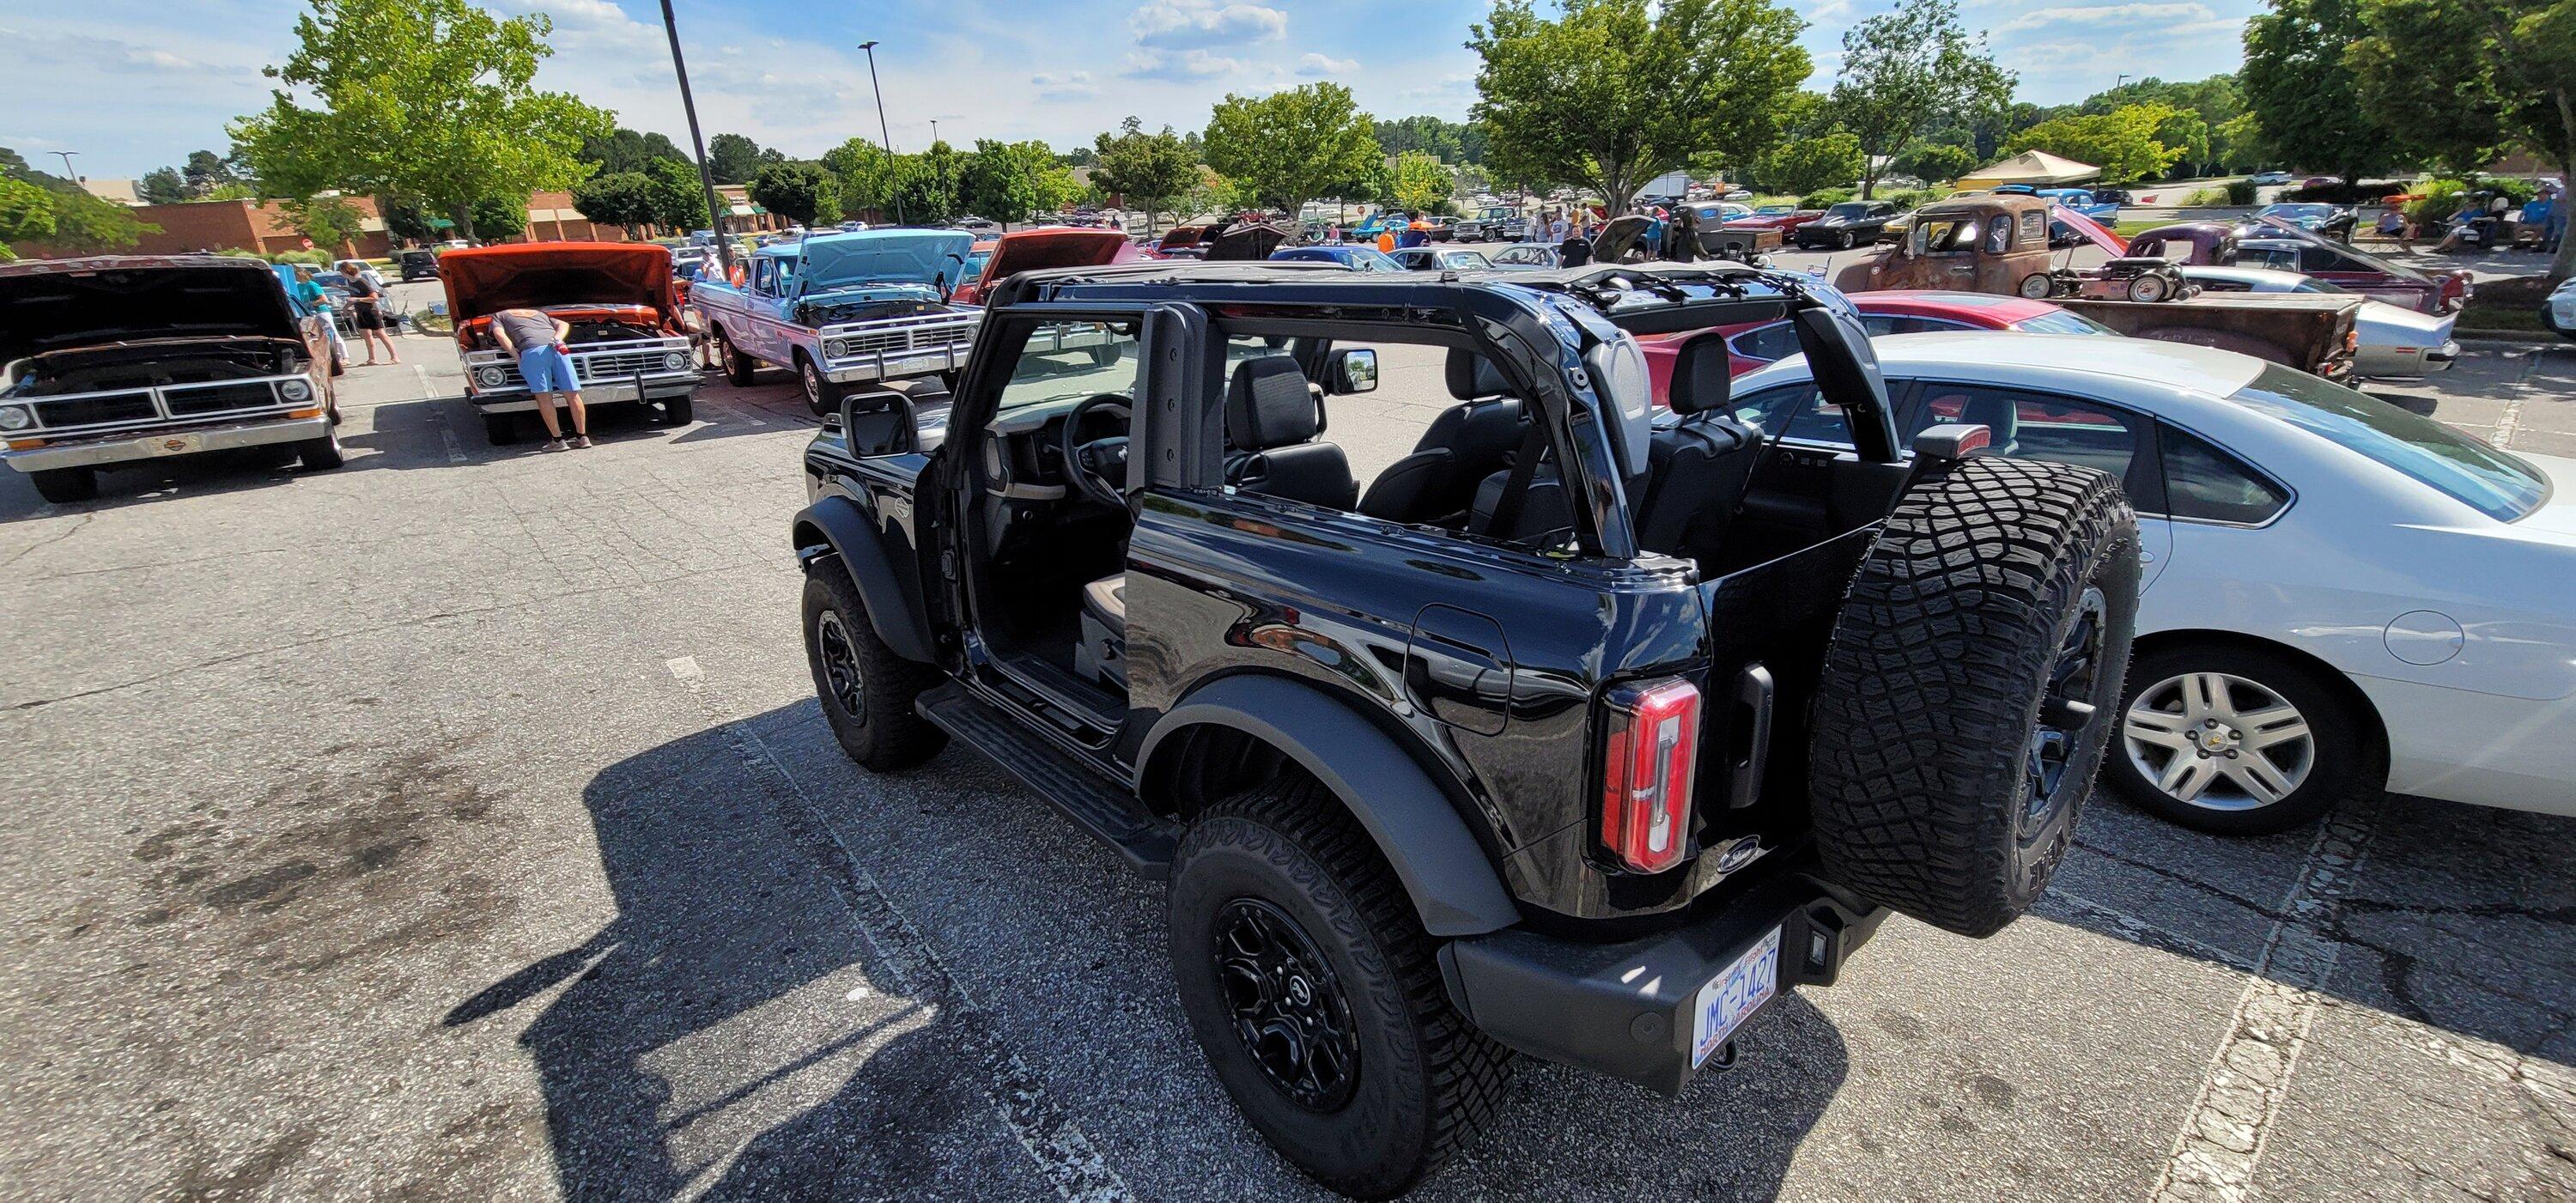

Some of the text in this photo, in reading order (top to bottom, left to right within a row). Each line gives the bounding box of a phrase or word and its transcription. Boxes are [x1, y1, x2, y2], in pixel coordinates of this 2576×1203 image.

[1700, 947, 1776, 1047] JMC-1427
[1700, 988, 1771, 1057] NORTH CAROLINA
